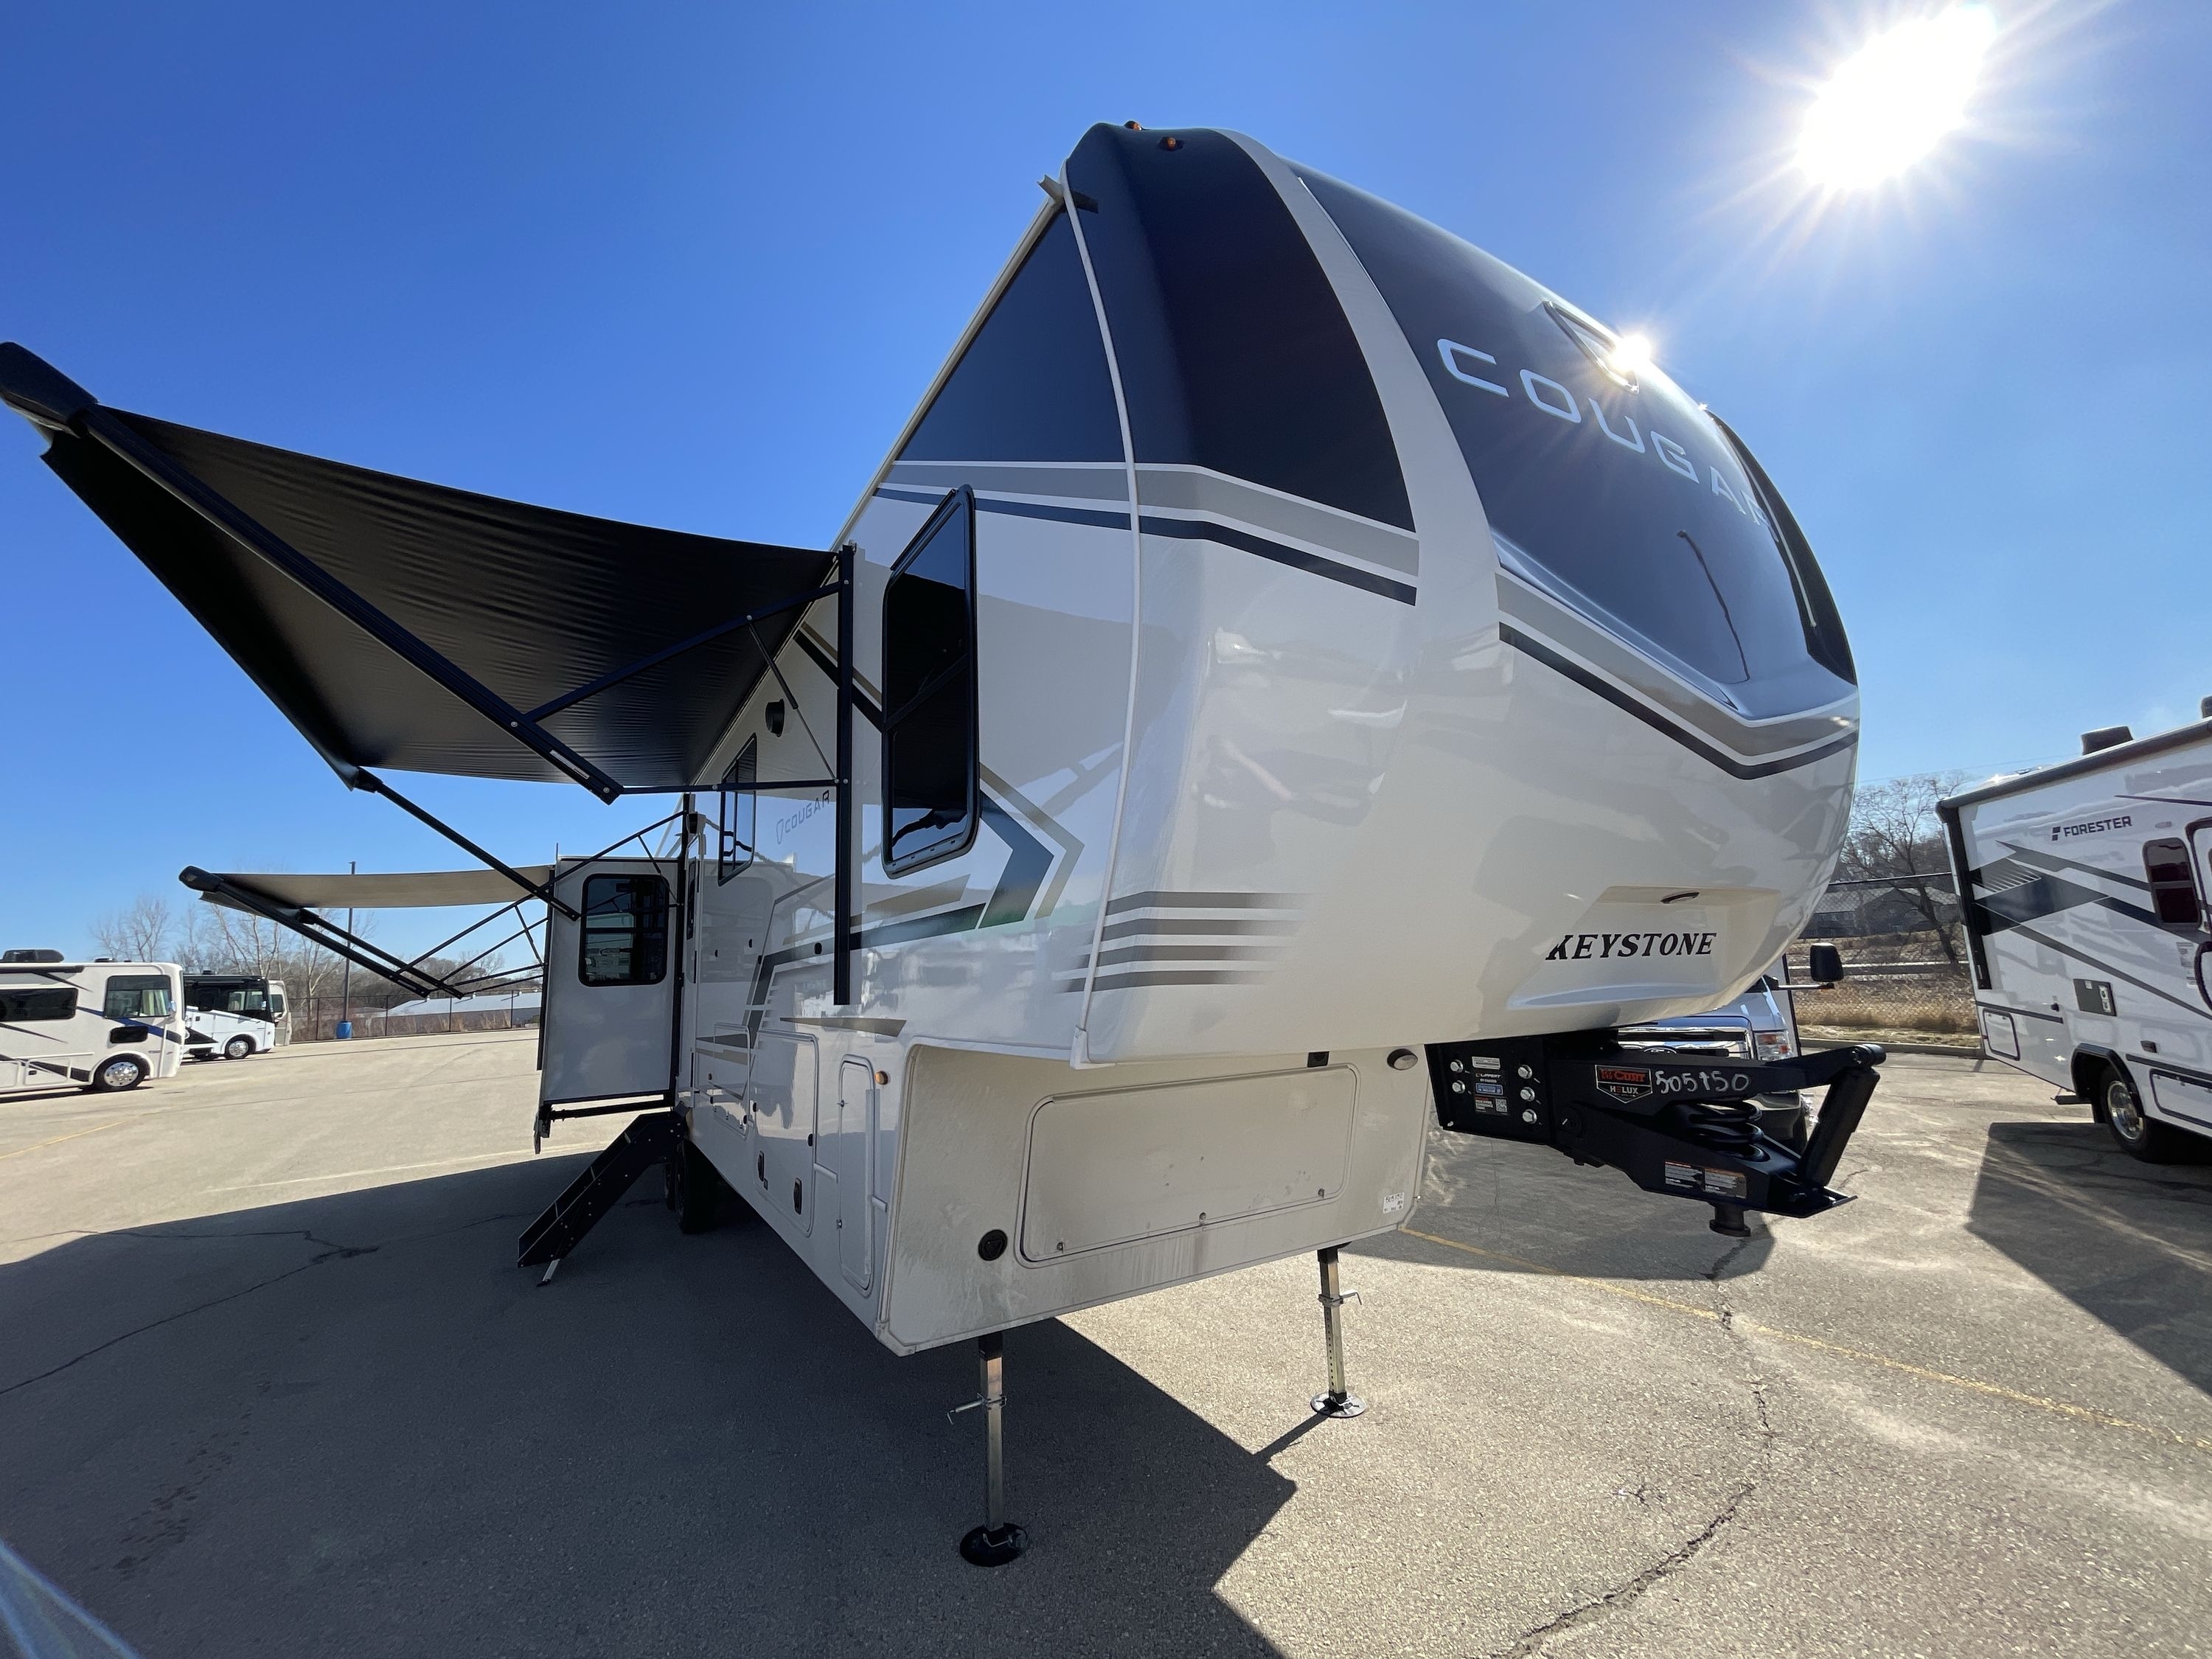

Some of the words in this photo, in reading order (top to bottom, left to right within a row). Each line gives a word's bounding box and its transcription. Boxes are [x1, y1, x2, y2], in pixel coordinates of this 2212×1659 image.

[1436, 338, 1780, 543] COUGAR
[785, 790, 830, 833] COUGAR
[2063, 815, 2132, 837] FORESTER
[1545, 932, 1717, 961] KEYSTONE
[1610, 1085, 1638, 1094] HELUX
[1655, 1070, 1750, 1094] 505150
